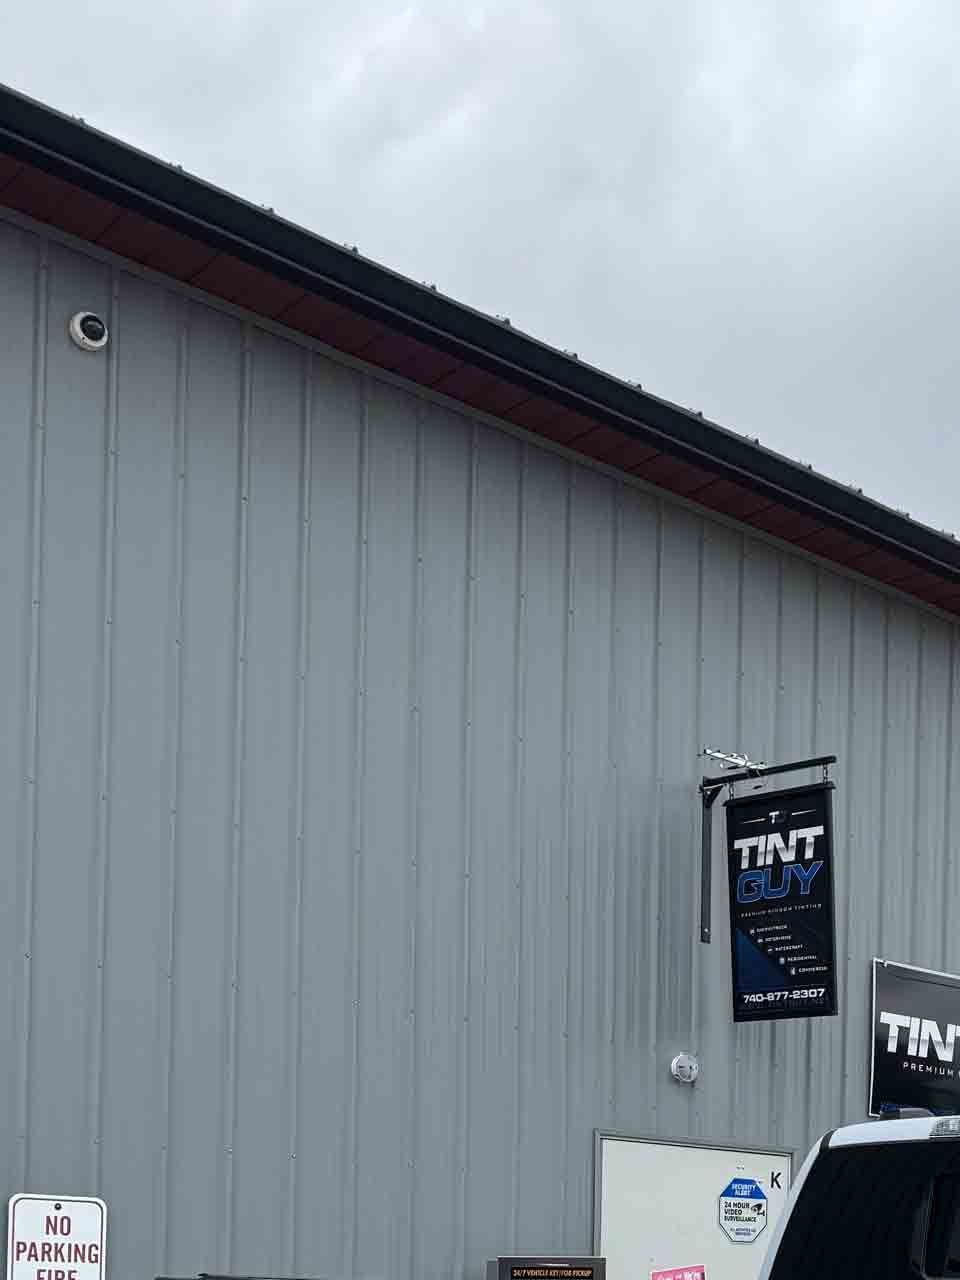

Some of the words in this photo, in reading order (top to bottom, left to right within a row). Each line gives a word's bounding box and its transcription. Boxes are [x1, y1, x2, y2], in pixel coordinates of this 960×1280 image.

[734, 825, 824, 869] TINT
[737, 860, 824, 903] GUY
[743, 988, 825, 1003] 740-877-2307
[903, 1061, 954, 1077] PREMIUM
[770, 1171, 782, 1189] K
[724, 1201, 732, 1209] 24
[733, 1201, 750, 1209] HOUR
[724, 1208, 743, 1216] VIDEO
[45, 1215, 72, 1237] NO
[724, 1215, 757, 1223] SURVEILLANCE
[15, 1241, 99, 1264] PARKING
